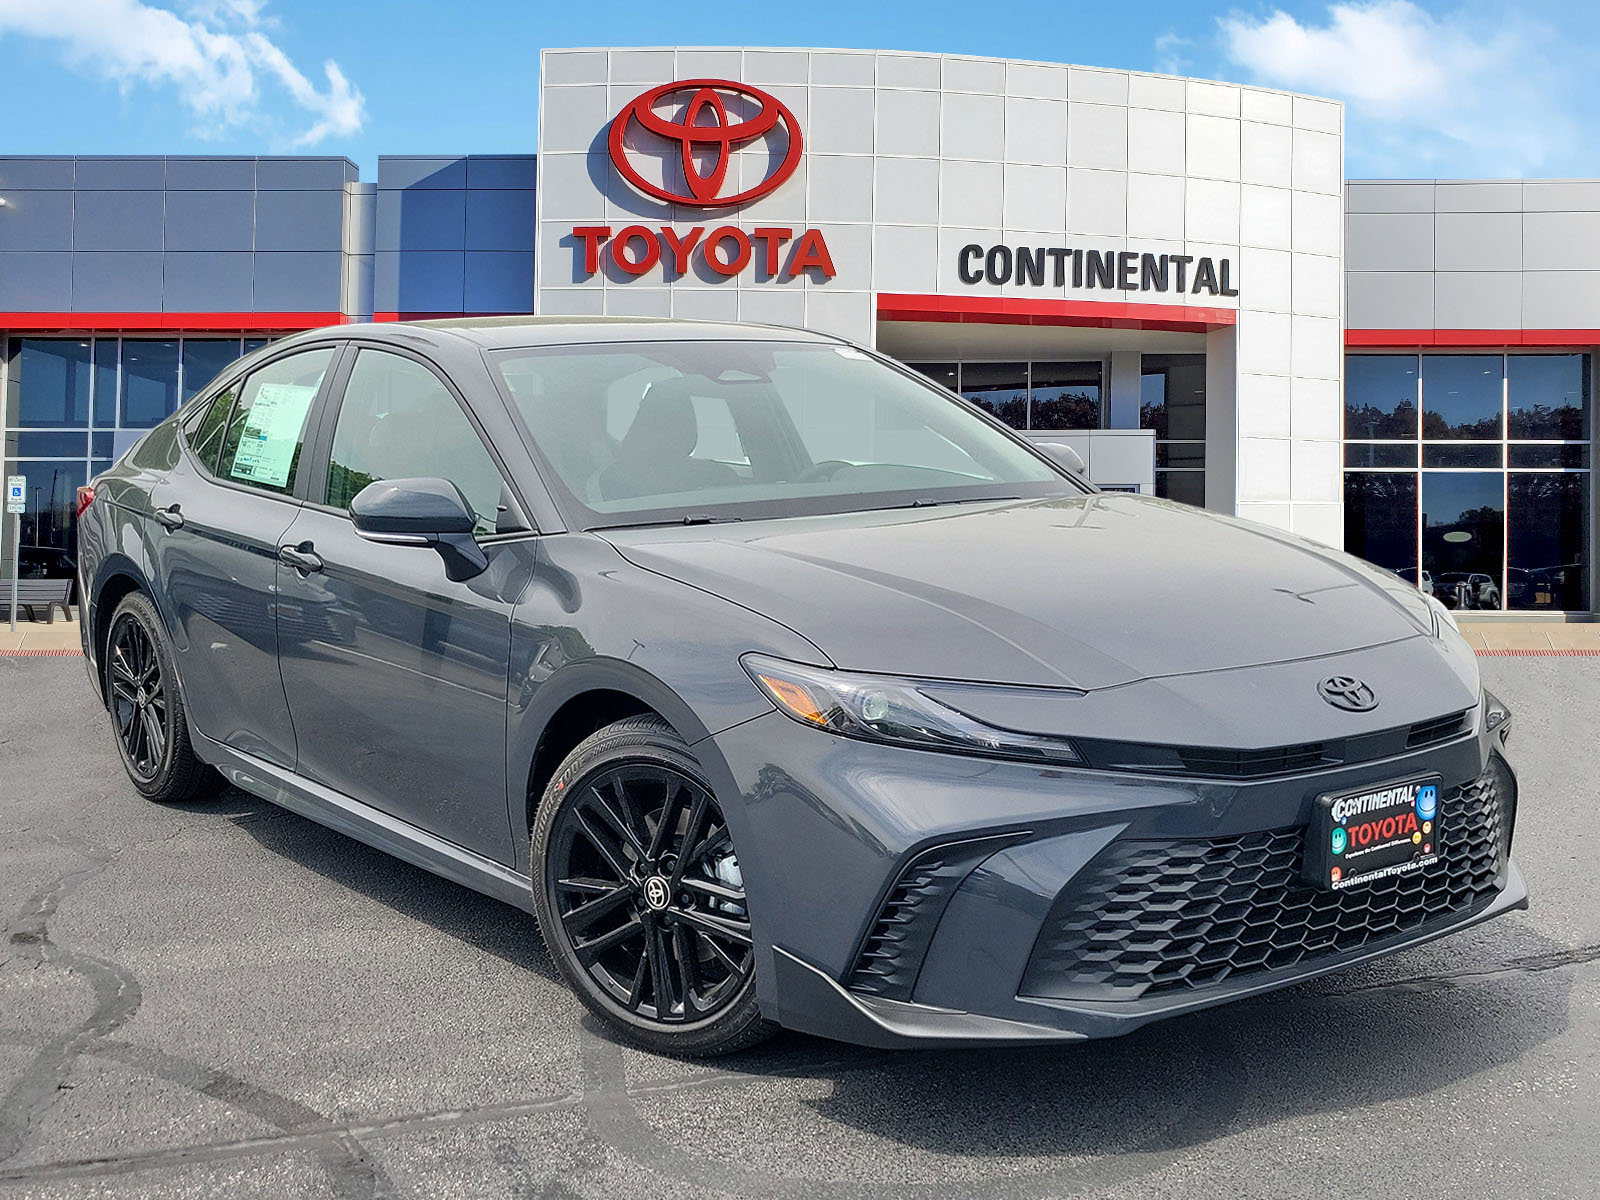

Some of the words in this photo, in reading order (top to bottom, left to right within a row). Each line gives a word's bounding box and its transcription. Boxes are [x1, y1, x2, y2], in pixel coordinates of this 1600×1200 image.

[572, 225, 837, 277] TOYOTA
[958, 244, 1239, 297] CONTINENTAL
[1331, 785, 1415, 822] CONTINENTAL
[1347, 812, 1418, 847] TOYOTA
[1331, 856, 1438, 890] ContinentalToyota.com
